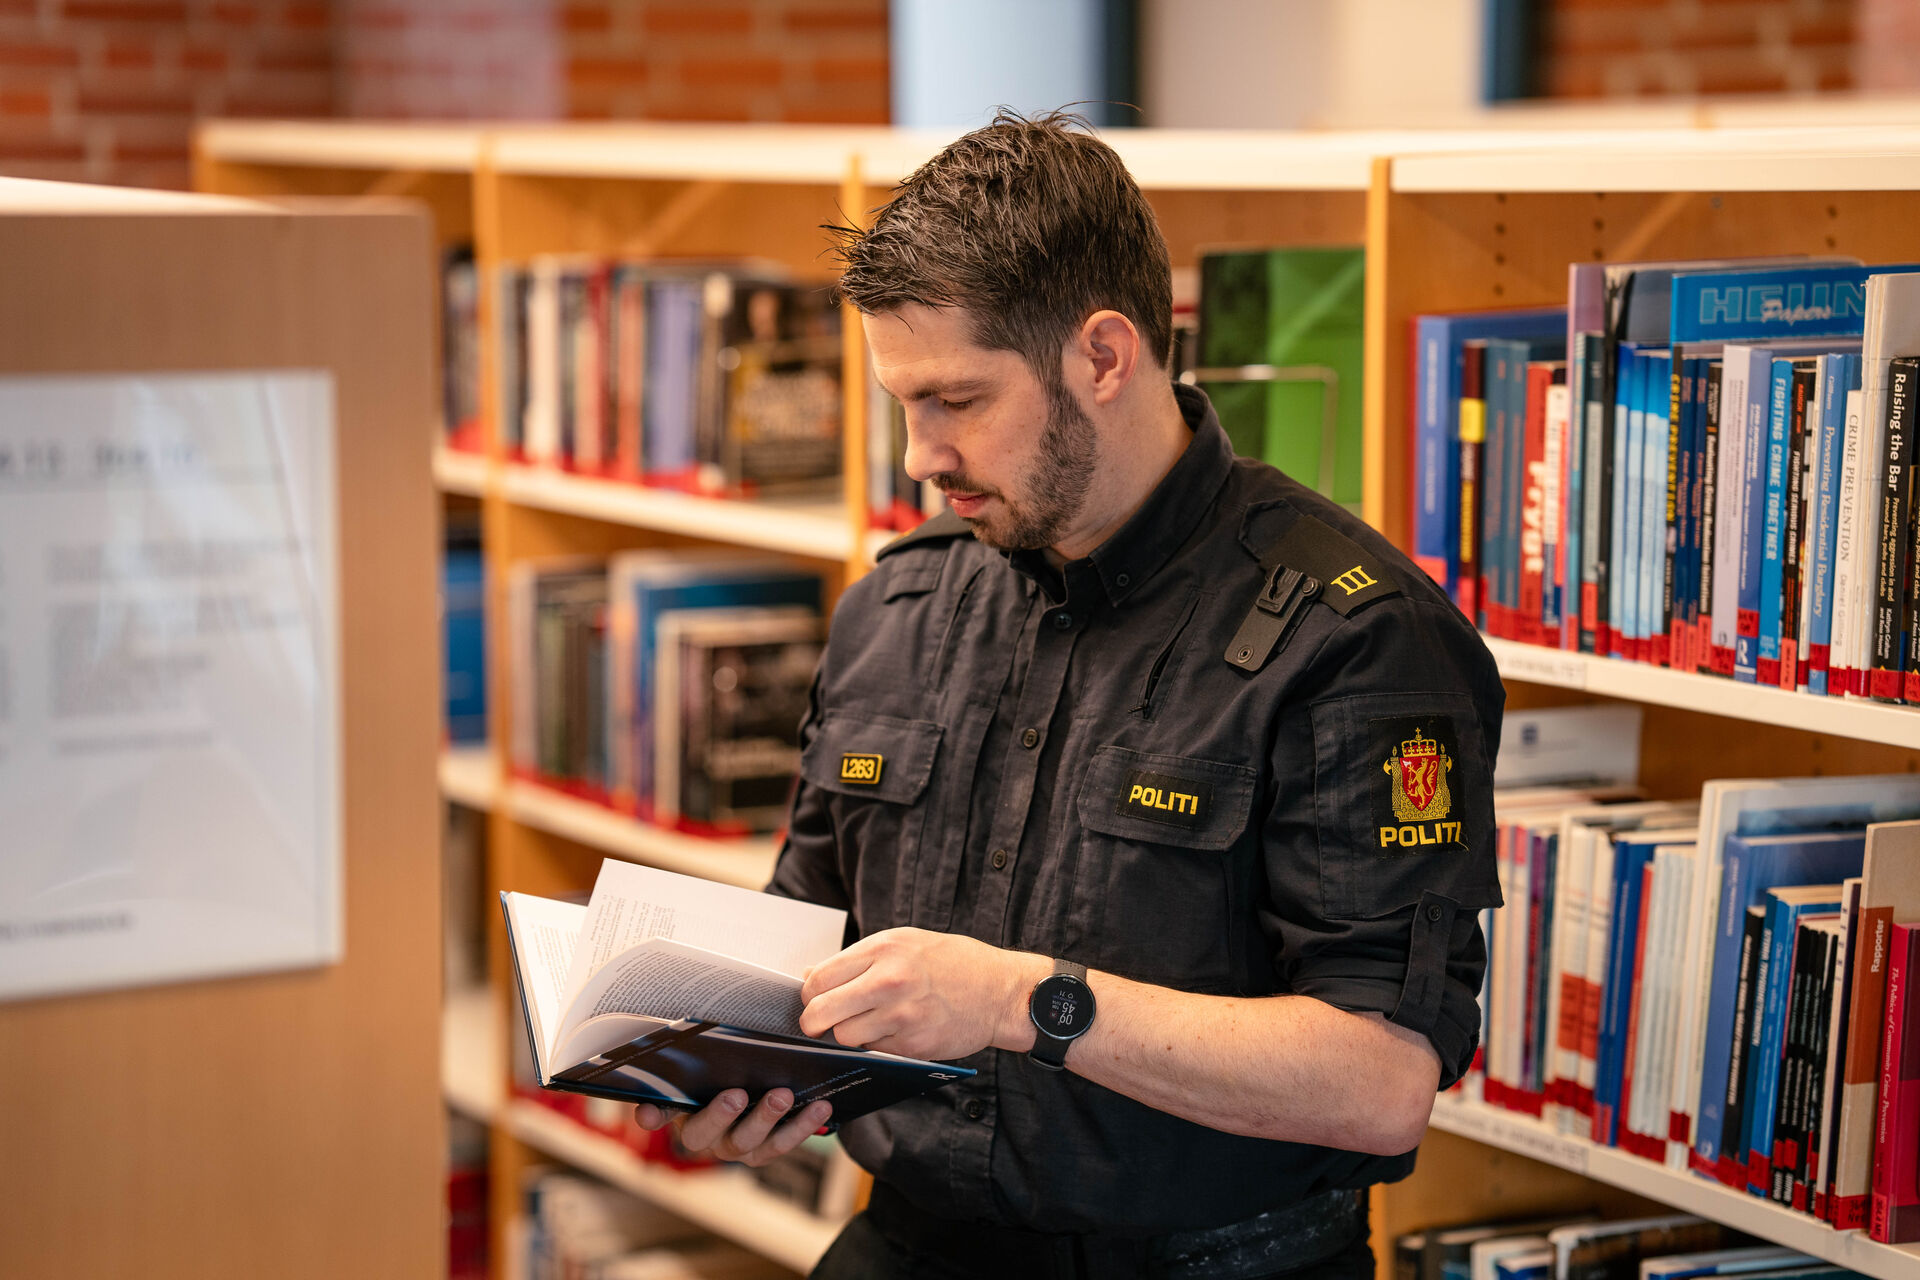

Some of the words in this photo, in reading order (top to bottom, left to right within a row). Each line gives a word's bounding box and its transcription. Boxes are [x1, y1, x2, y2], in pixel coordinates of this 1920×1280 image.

[1771, 378, 1786, 441] FIGHTING
[1889, 373, 1907, 430] Raising
[1847, 414, 1858, 462] CRIME
[1890, 434, 1903, 461] the
[1769, 444, 1783, 486] CRIME
[1791, 451, 1801, 492] FIGHTING
[1821, 426, 1835, 492] Preventing
[1888, 465, 1901, 491] Bar
[1765, 492, 1780, 560] TOGETHER
[1817, 494, 1832, 561] Residential
[1841, 466, 1854, 561] PREVENTION
[1889, 497, 1900, 537] Preventing
[1881, 542, 1889, 561] pubs
[1888, 538, 1897, 577] aggression
[1814, 563, 1828, 617] Burglary
[1887, 587, 1895, 602] and
[1888, 578, 1896, 586] in
[1885, 608, 1893, 633] Kathryn
[841, 757, 876, 779] L263
[1128, 784, 1199, 815] POLITI
[1380, 821, 1461, 848] POLITI
[1870, 919, 1885, 973] Rapporter
[1892, 967, 1900, 982] The
[1062, 1001, 1076, 1014] 45
[1888, 983, 1898, 1013] Politics
[1059, 1012, 1073, 1025] 09
[1887, 1014, 1896, 1026] of
[1884, 1025, 1895, 1072] Community
[1882, 1073, 1892, 1099] Crime
[1879, 1100, 1890, 1144] Prevention
